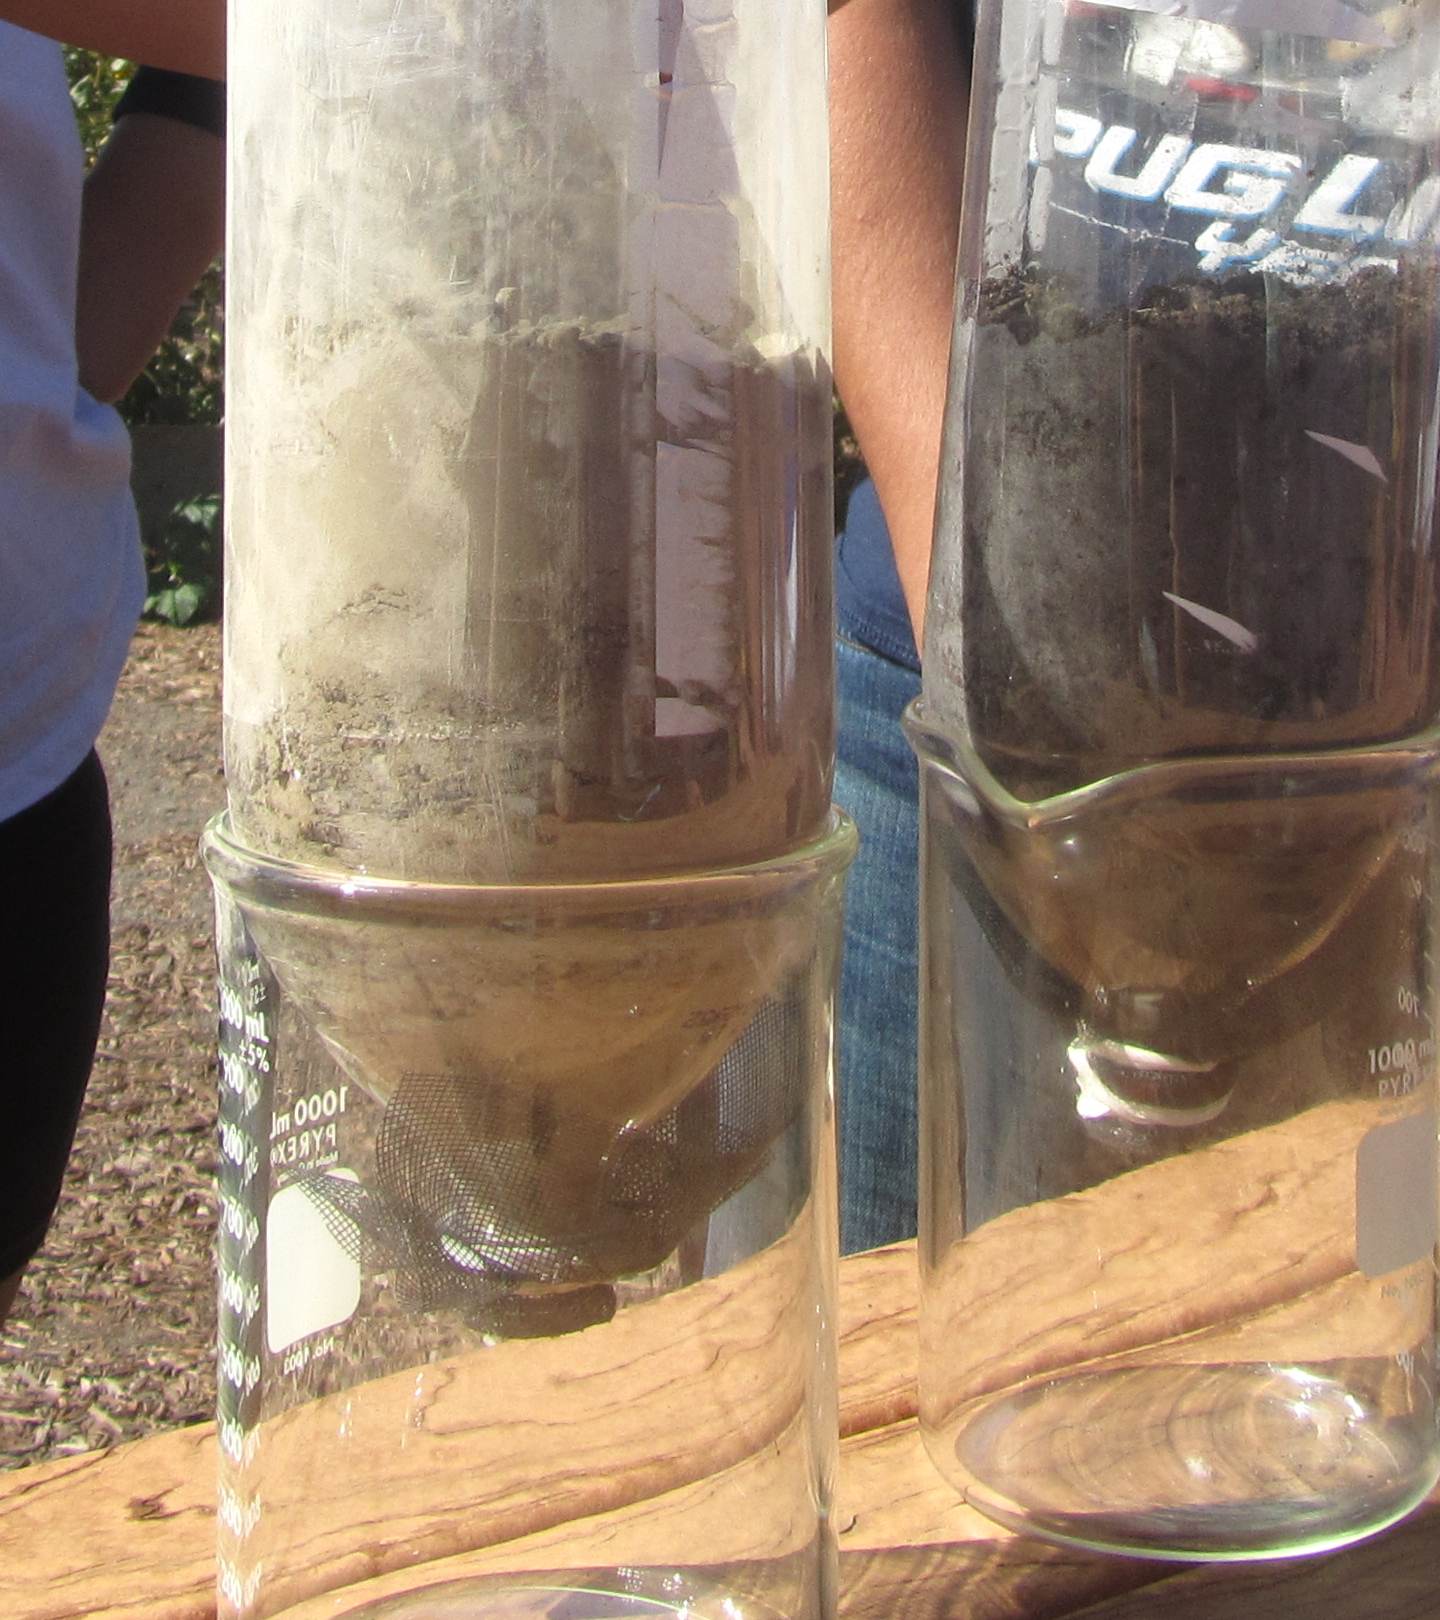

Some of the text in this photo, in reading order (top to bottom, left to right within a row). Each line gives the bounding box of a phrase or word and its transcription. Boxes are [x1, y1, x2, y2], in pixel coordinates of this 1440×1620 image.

[1028, 107, 1303, 220] PUG
[245, 1012, 269, 1043] mL
[239, 1038, 269, 1073] ±5%
[1368, 1036, 1417, 1075] 1000
